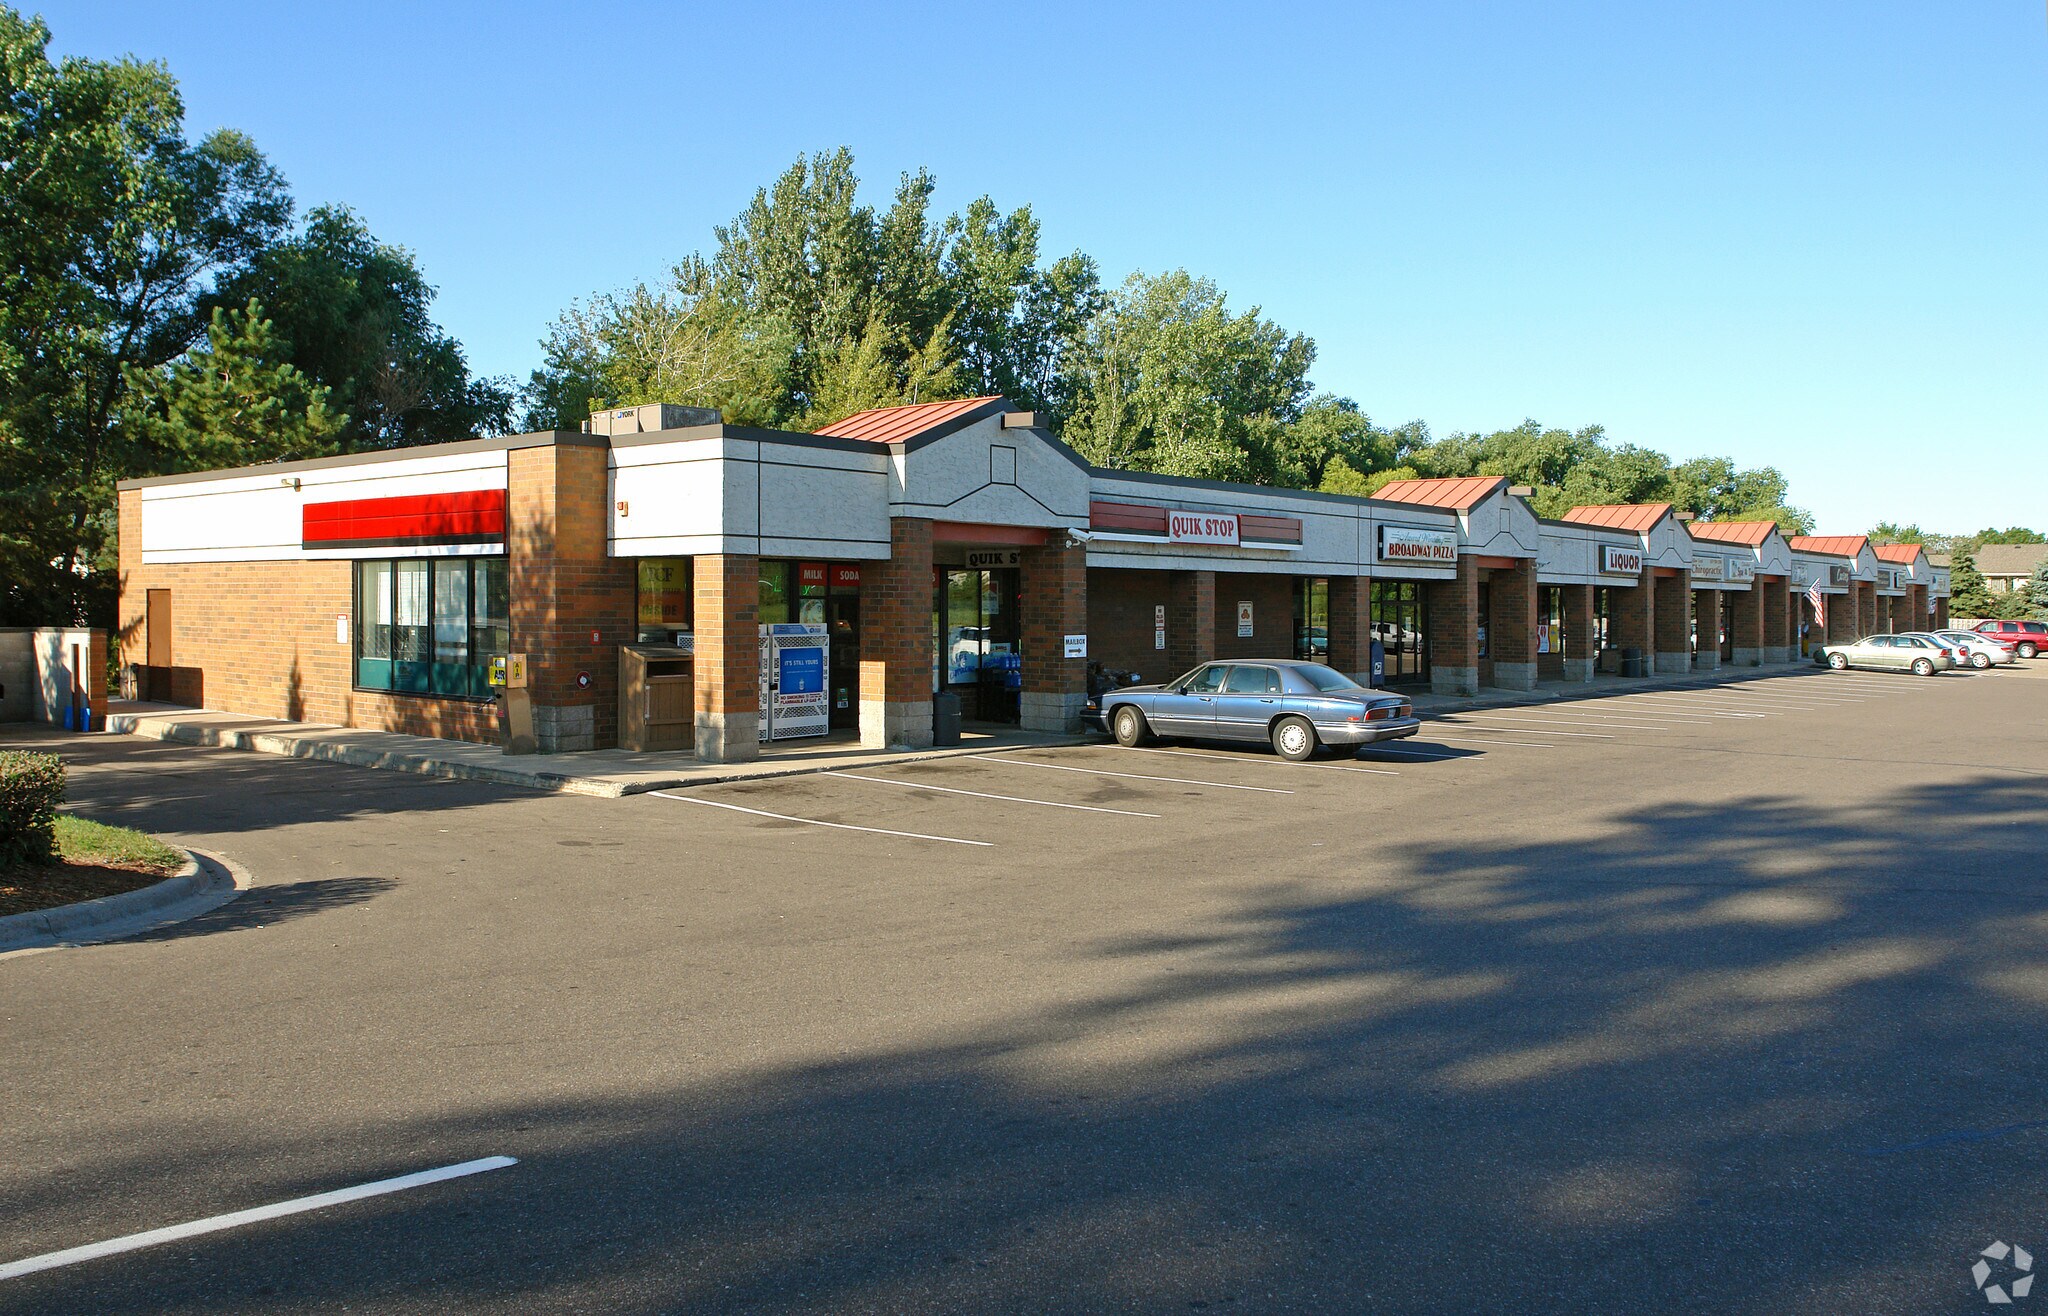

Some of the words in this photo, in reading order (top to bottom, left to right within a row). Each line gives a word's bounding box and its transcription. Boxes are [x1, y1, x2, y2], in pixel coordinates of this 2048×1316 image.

[622, 410, 635, 418] YORK
[1172, 516, 1203, 538] QUIK
[1205, 518, 1234, 537] STOP
[1389, 543, 1432, 558] BROADWAY
[1433, 545, 1455, 559] PIZZA
[969, 552, 1004, 566] QUIK
[1009, 552, 1020, 564] S
[1610, 552, 1640, 570] LIQUOR
[647, 567, 674, 582] TCF
[803, 569, 823, 580] MILK
[839, 570, 860, 581] SODA
[1691, 563, 1723, 577] Chiropractic
[1065, 638, 1086, 646] MAILBOX
[493, 669, 506, 681] AIR
